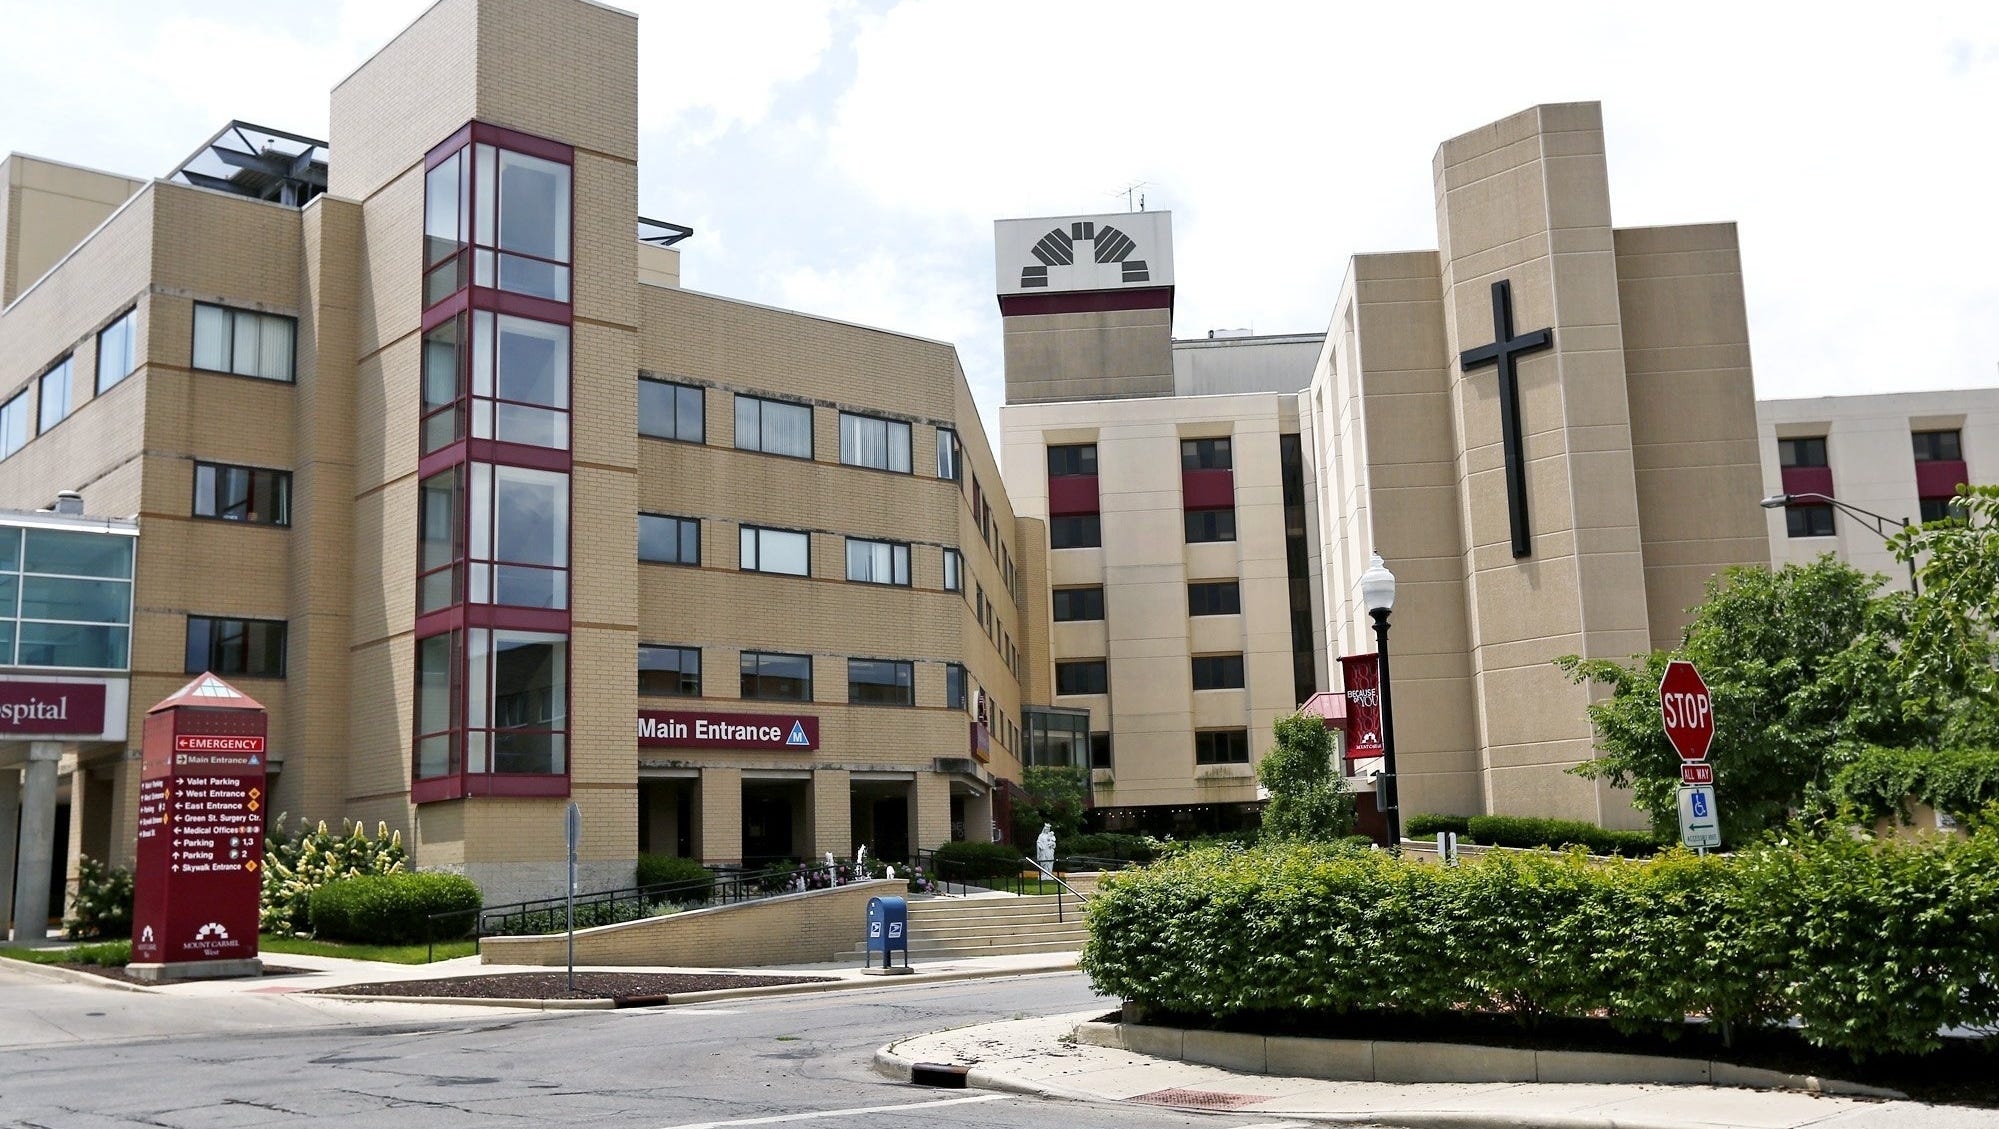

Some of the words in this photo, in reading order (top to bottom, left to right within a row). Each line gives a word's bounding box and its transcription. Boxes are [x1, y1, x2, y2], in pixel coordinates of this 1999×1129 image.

[1347, 689, 1376, 698] BECAUSE
[1359, 695, 1378, 707] YOU
[0, 696, 68, 725] spital
[1664, 693, 1709, 729] STOP
[638, 718, 687, 739] Main
[695, 719, 782, 742] Entrance
[792, 732, 803, 743] M
[189, 738, 257, 749] EMERGENCY
[188, 756, 209, 764] Main
[210, 756, 248, 764] Entrance
[1684, 768, 1694, 780] ALL
[1696, 768, 1709, 780] WAY
[186, 778, 207, 786] Valet
[210, 778, 240, 787] Parking
[185, 790, 207, 798] West
[209, 790, 246, 798] Entrance
[184, 802, 204, 810] East
[206, 802, 243, 810] Entrance
[184, 814, 206, 822] Green
[207, 814, 218, 822] St.
[220, 814, 247, 823] Surgery
[248, 813, 262, 821] Ctr.
[183, 826, 212, 834] Medical
[213, 826, 239, 834] Offices
[183, 839, 215, 848] Parking
[242, 838, 254, 846] 1,3
[182, 851, 214, 860] Parking
[241, 850, 248, 858] 2
[182, 863, 211, 873] Skywalk
[211, 863, 242, 871] Entrance
[183, 941, 210, 949] MOUNT
[211, 940, 240, 948] CARMEL
